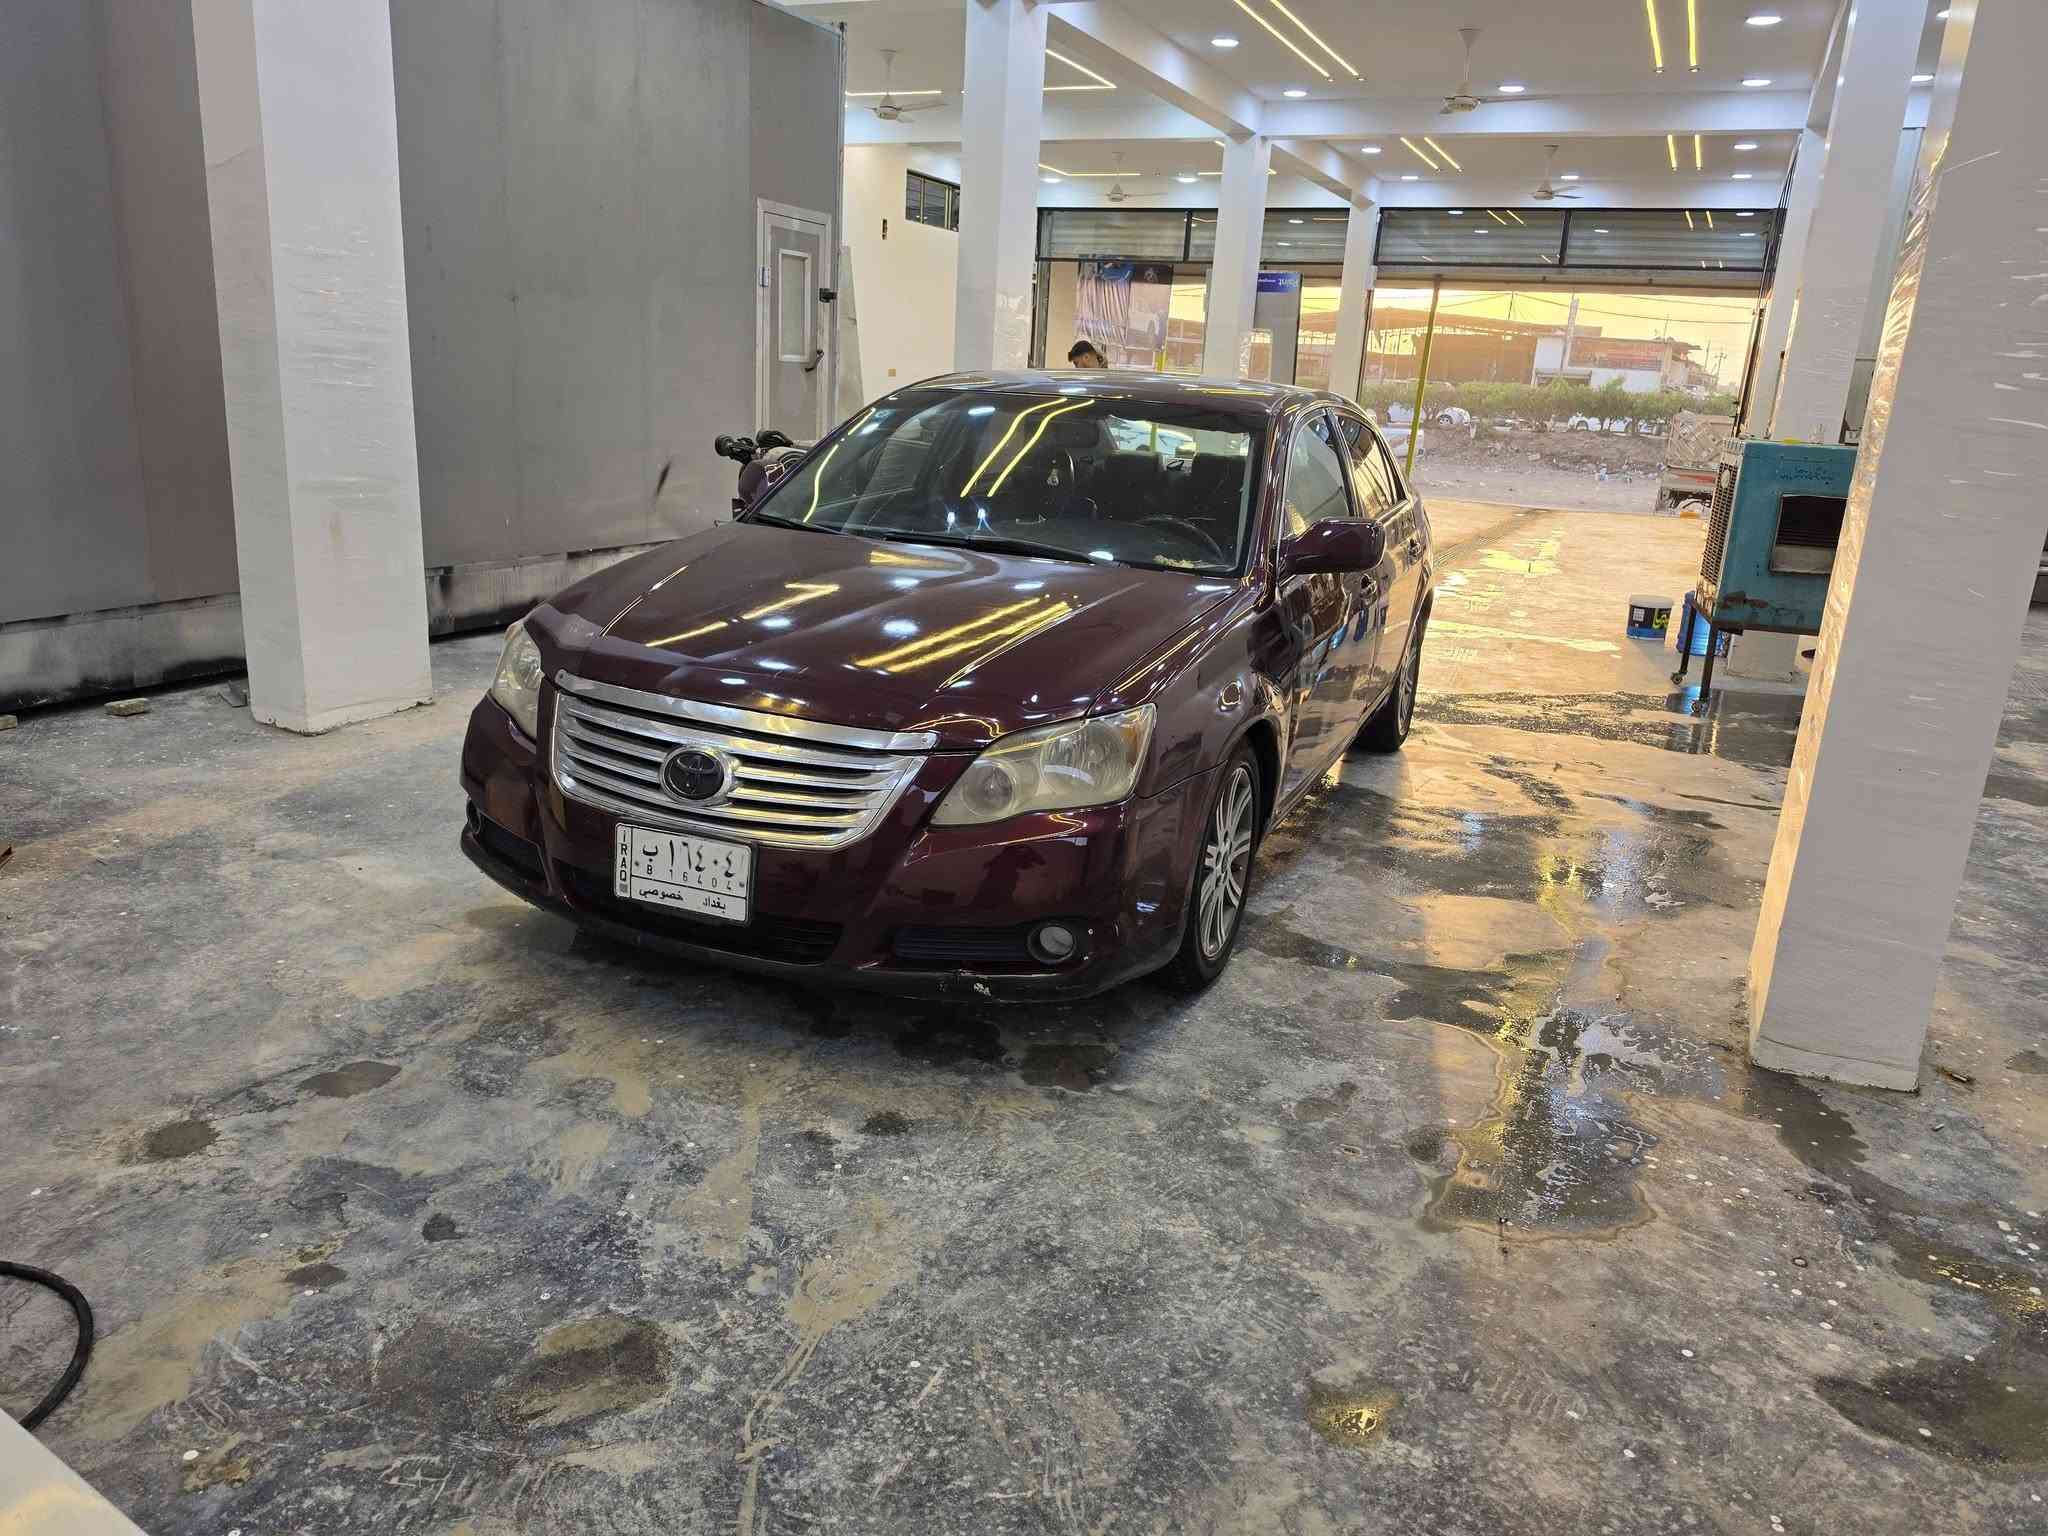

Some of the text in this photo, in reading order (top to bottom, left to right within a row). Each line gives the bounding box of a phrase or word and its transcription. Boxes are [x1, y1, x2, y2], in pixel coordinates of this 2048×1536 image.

[619, 829, 628, 882] IRAQ
[642, 839, 737, 878] ب ١٦٤٠٤
[646, 864, 733, 891] B 16404
[639, 887, 726, 914] بغداد خصوصي
